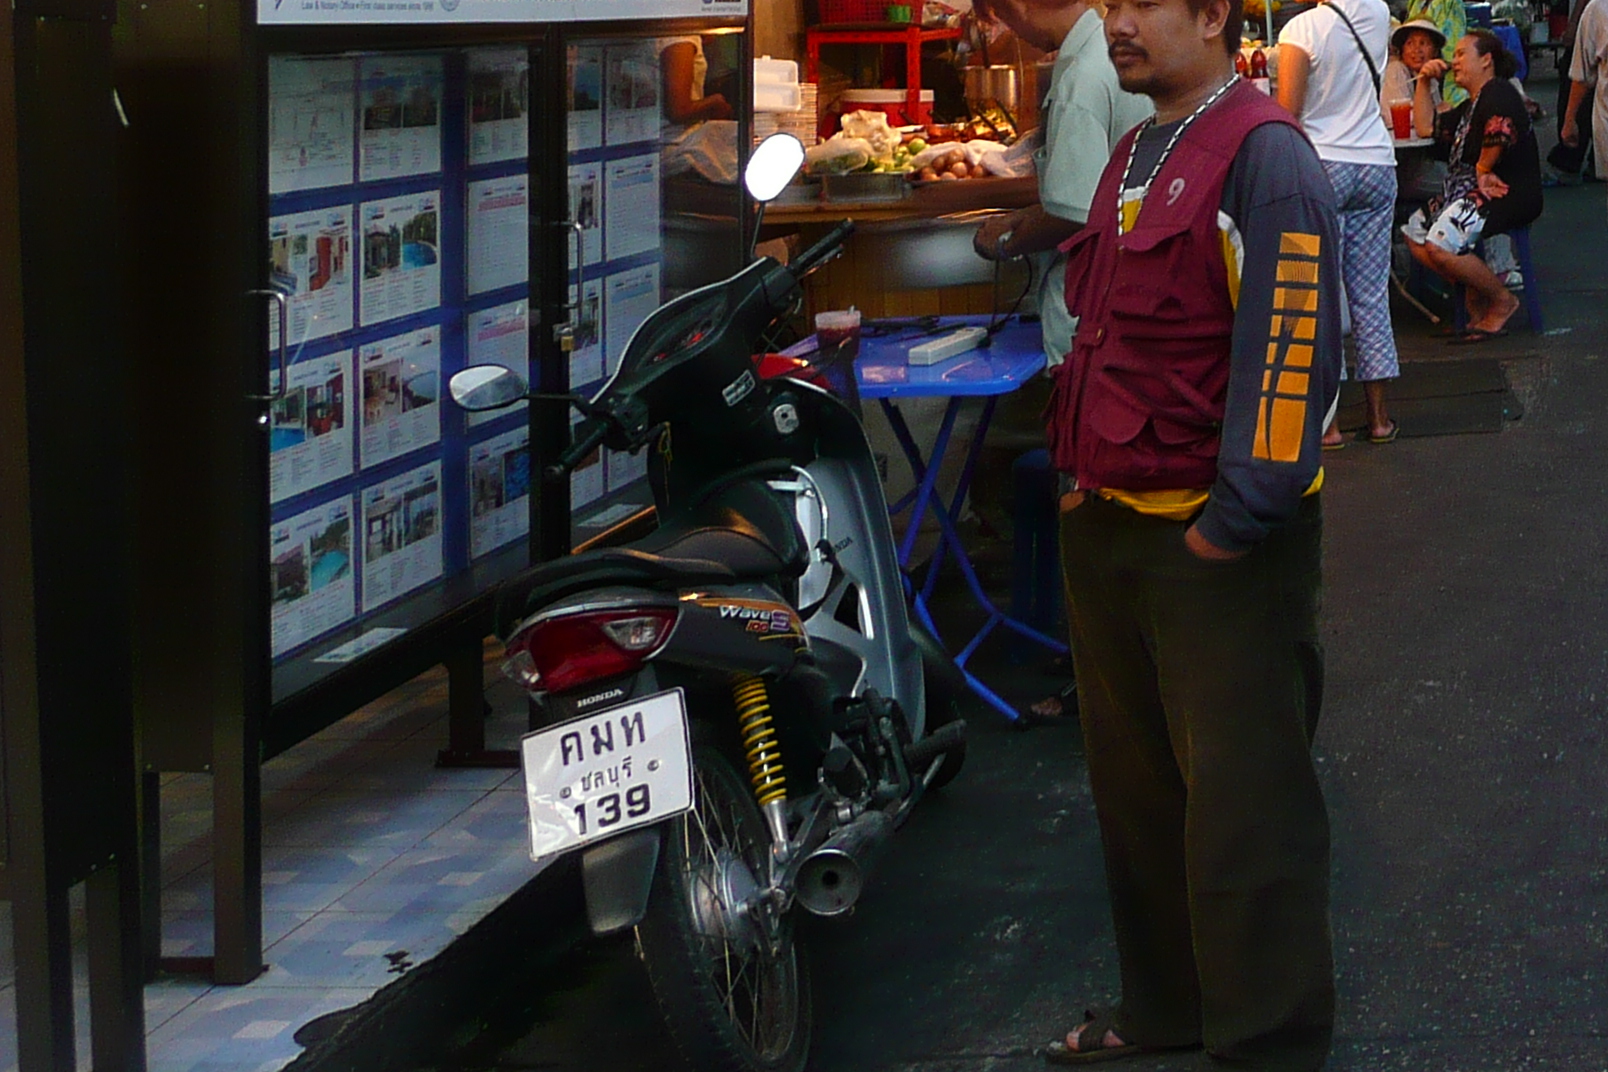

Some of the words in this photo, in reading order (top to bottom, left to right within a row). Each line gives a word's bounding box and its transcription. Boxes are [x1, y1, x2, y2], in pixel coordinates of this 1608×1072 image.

[719, 605, 770, 620] Wave
[577, 688, 624, 708] HONDA
[560, 711, 646, 766] คมท
[581, 756, 632, 788] ชลบุรี
[574, 783, 650, 836] 139
